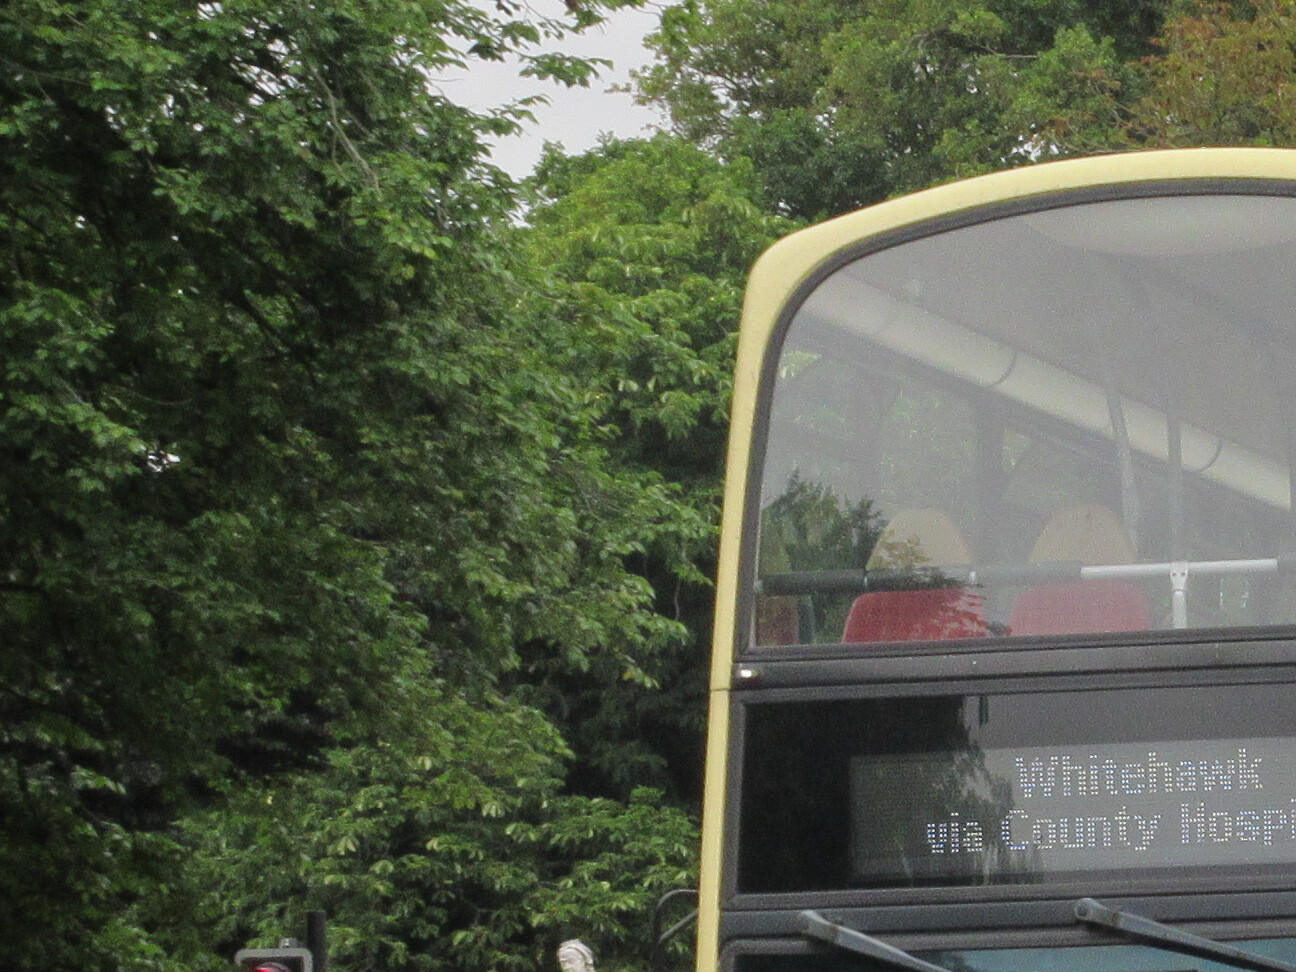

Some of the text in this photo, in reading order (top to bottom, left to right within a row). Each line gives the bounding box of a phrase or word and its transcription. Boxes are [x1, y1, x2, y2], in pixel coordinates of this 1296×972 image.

[1015, 748, 1263, 798] Whitehawk
[926, 813, 984, 854] via
[1001, 806, 1162, 851] County
